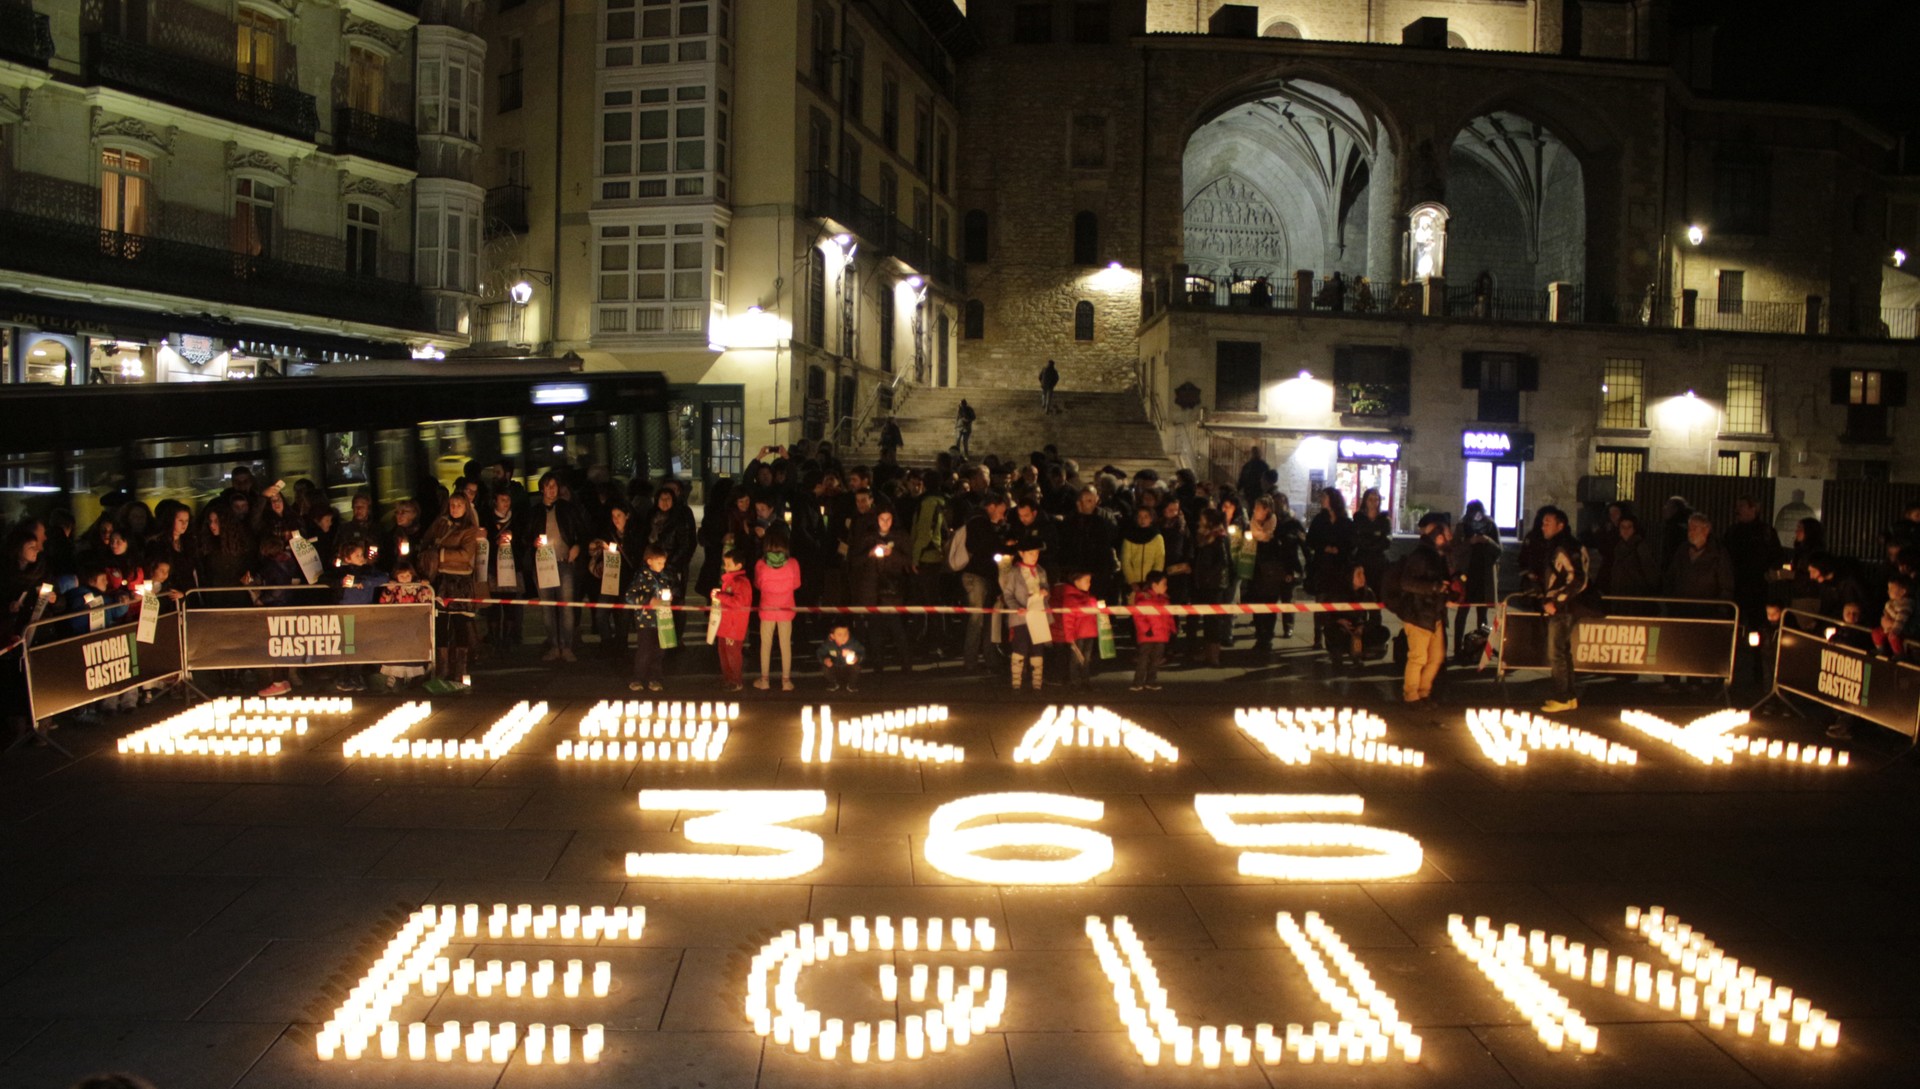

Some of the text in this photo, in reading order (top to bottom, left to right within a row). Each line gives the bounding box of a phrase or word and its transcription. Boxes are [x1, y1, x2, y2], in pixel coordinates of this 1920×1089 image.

[1464, 432, 1511, 450] ROMA
[144, 595, 158, 606] 365
[267, 615, 342, 636] VITORIA
[1578, 624, 1646, 645] VITORIA
[82, 634, 130, 667] VITORIA
[268, 635, 342, 658] GASTEIZ
[1576, 643, 1645, 665] GASTEIZ
[85, 656, 132, 691] GASTEIZ
[1821, 648, 1863, 682] VITORIA
[1817, 671, 1861, 705] GASTEIZ
[625, 790, 1424, 883] 365
[316, 904, 1841, 1067] EGUN
